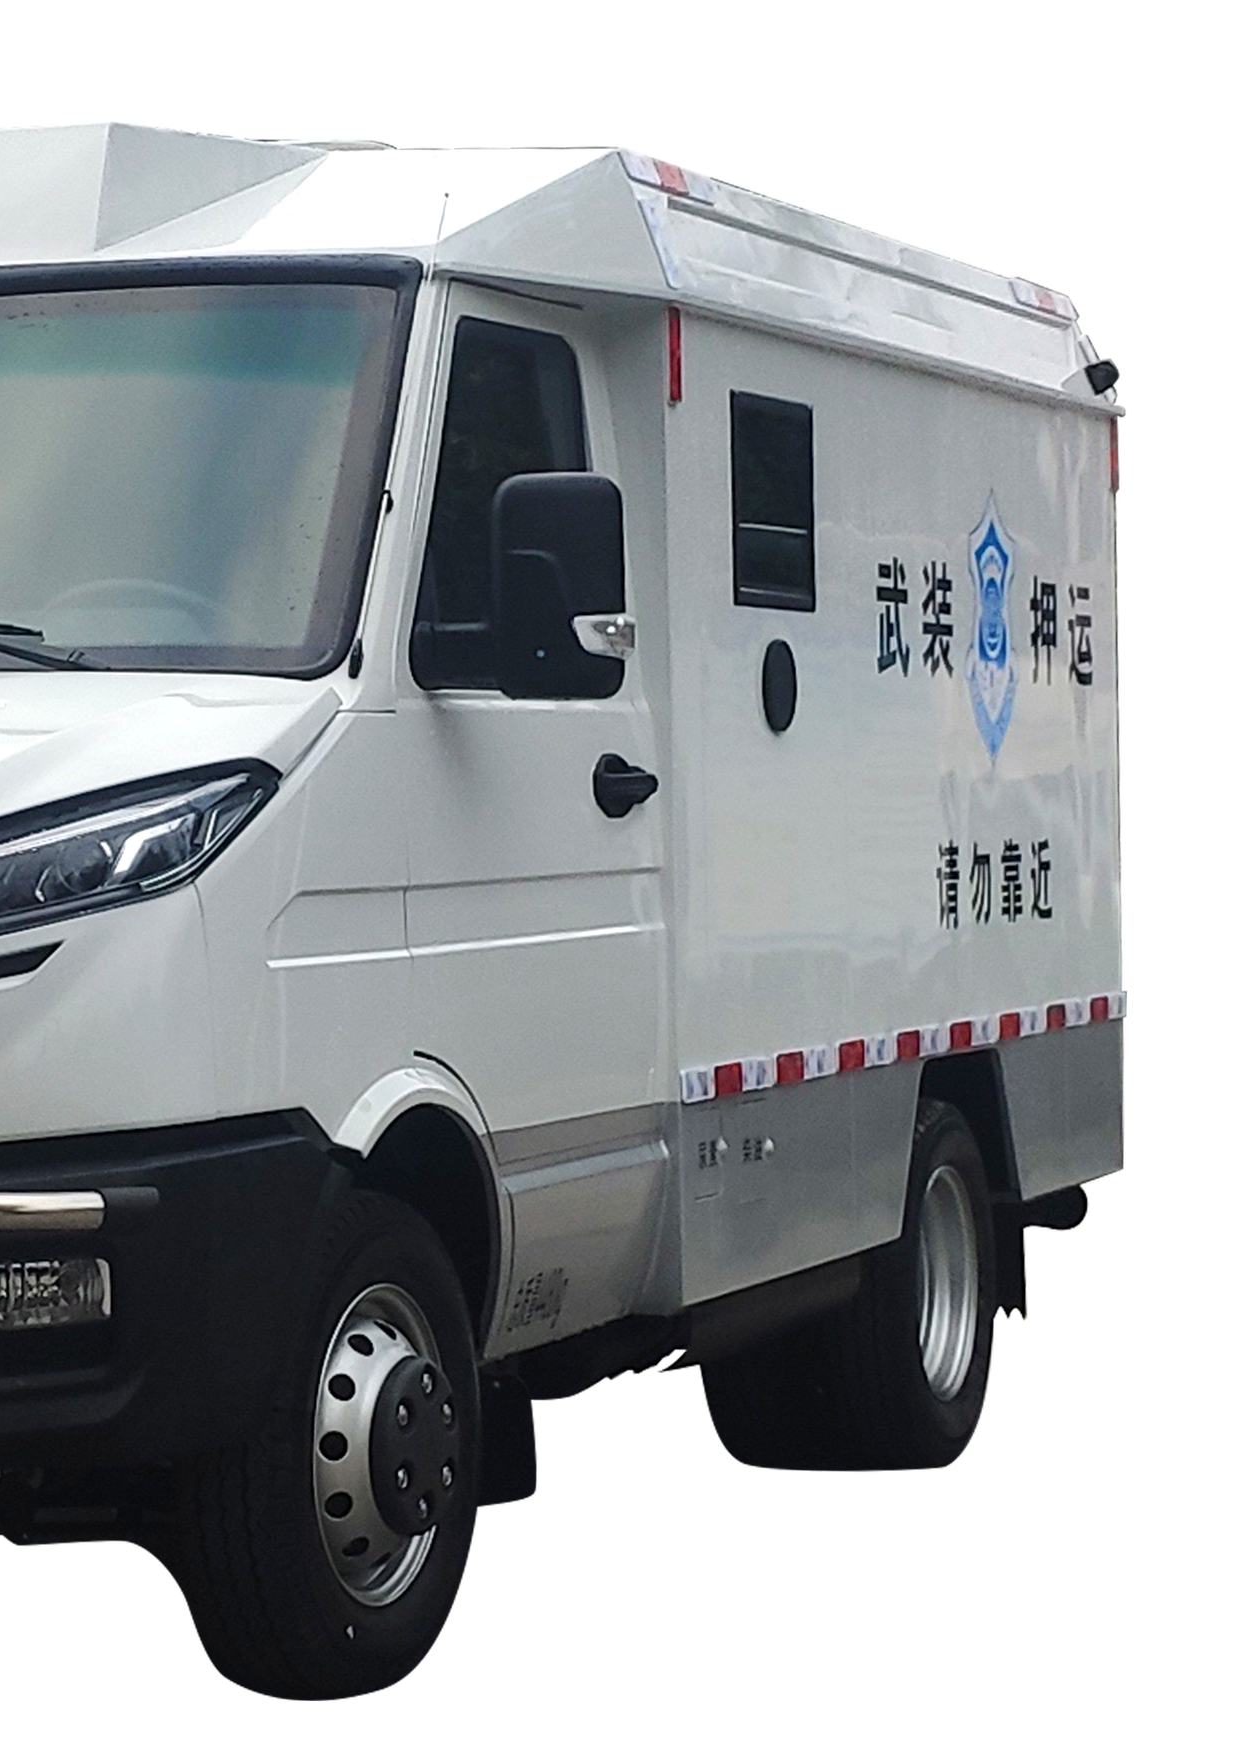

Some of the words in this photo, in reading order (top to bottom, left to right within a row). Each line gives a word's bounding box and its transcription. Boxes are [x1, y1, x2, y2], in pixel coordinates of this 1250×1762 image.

[876, 557, 954, 677] 武装
[1029, 576, 1093, 686] 押运
[936, 838, 1053, 930] 请勿靠近
